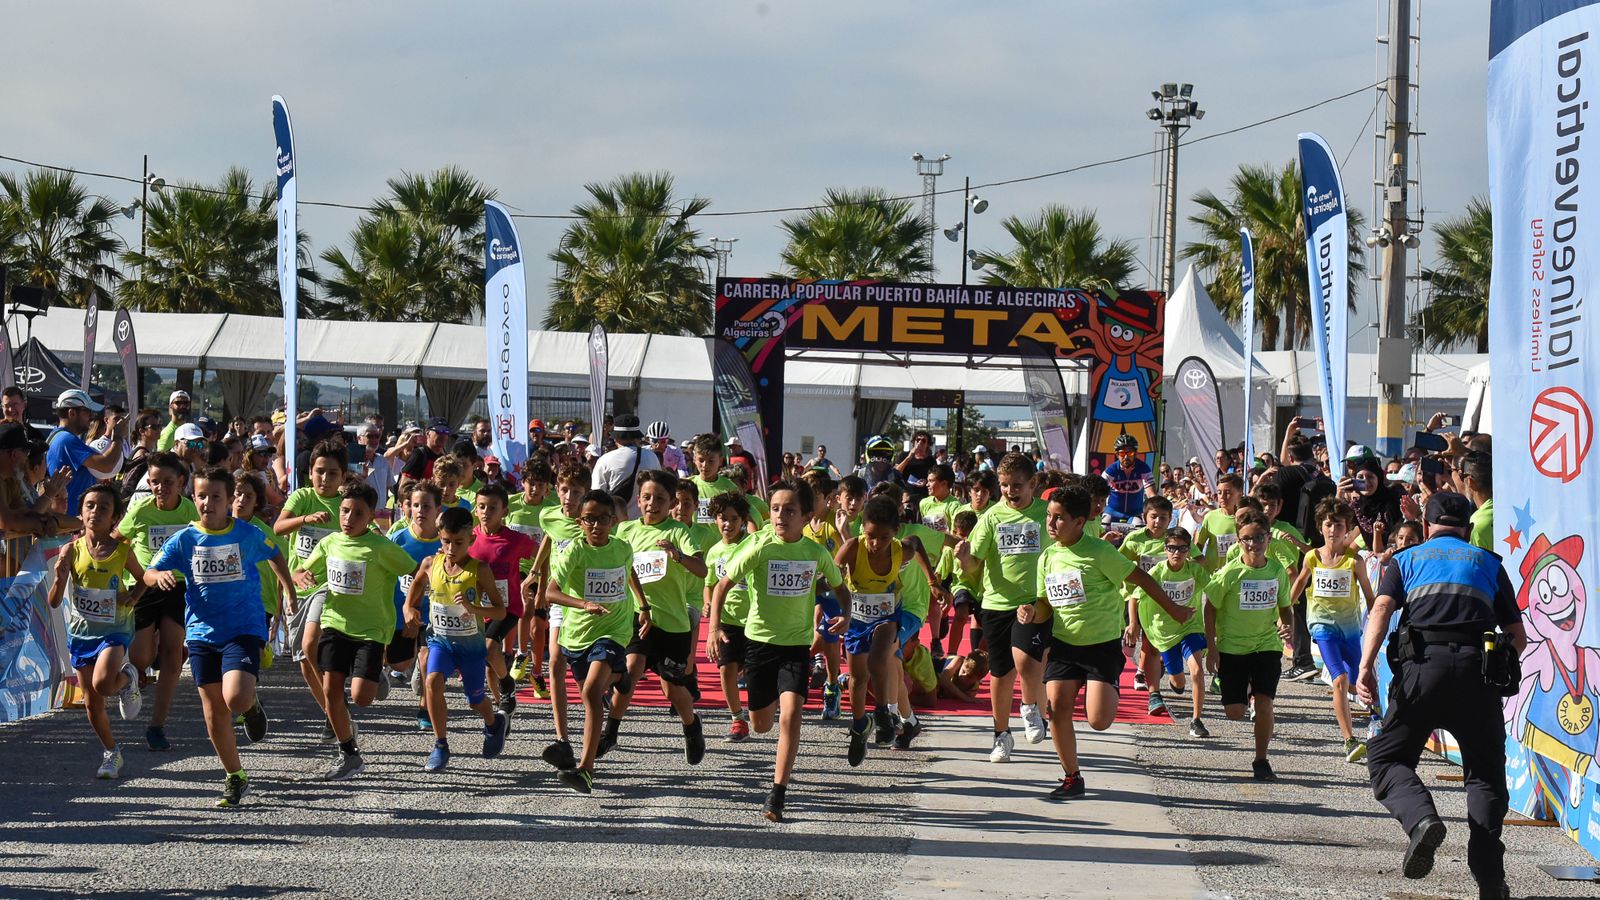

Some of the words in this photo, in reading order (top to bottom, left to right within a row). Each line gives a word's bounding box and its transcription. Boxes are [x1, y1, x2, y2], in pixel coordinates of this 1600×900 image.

[723, 282, 790, 299] CARRERA
[796, 284, 861, 301] POPULAR
[866, 286, 922, 303] PUERTO
[926, 286, 970, 305] BAHÍA
[974, 290, 993, 305] DE
[997, 291, 1076, 308] ALGECIRAS
[733, 319, 759, 328] Puerto
[760, 320, 770, 328] de
[802, 304, 1077, 350] META
[723, 327, 770, 338] Algeciras
[1000, 533, 1026, 546] 1353
[195, 559, 226, 573] 1263
[635, 562, 652, 576] 390
[328, 569, 349, 584] 1081
[771, 572, 801, 588] 1387
[588, 580, 617, 594] 1205
[1047, 583, 1070, 598] 1355
[1316, 578, 1339, 590] 1545
[1243, 590, 1268, 603] 1350
[75, 597, 100, 613] 1522
[852, 601, 880, 616] 1485
[434, 614, 461, 628] 1553
